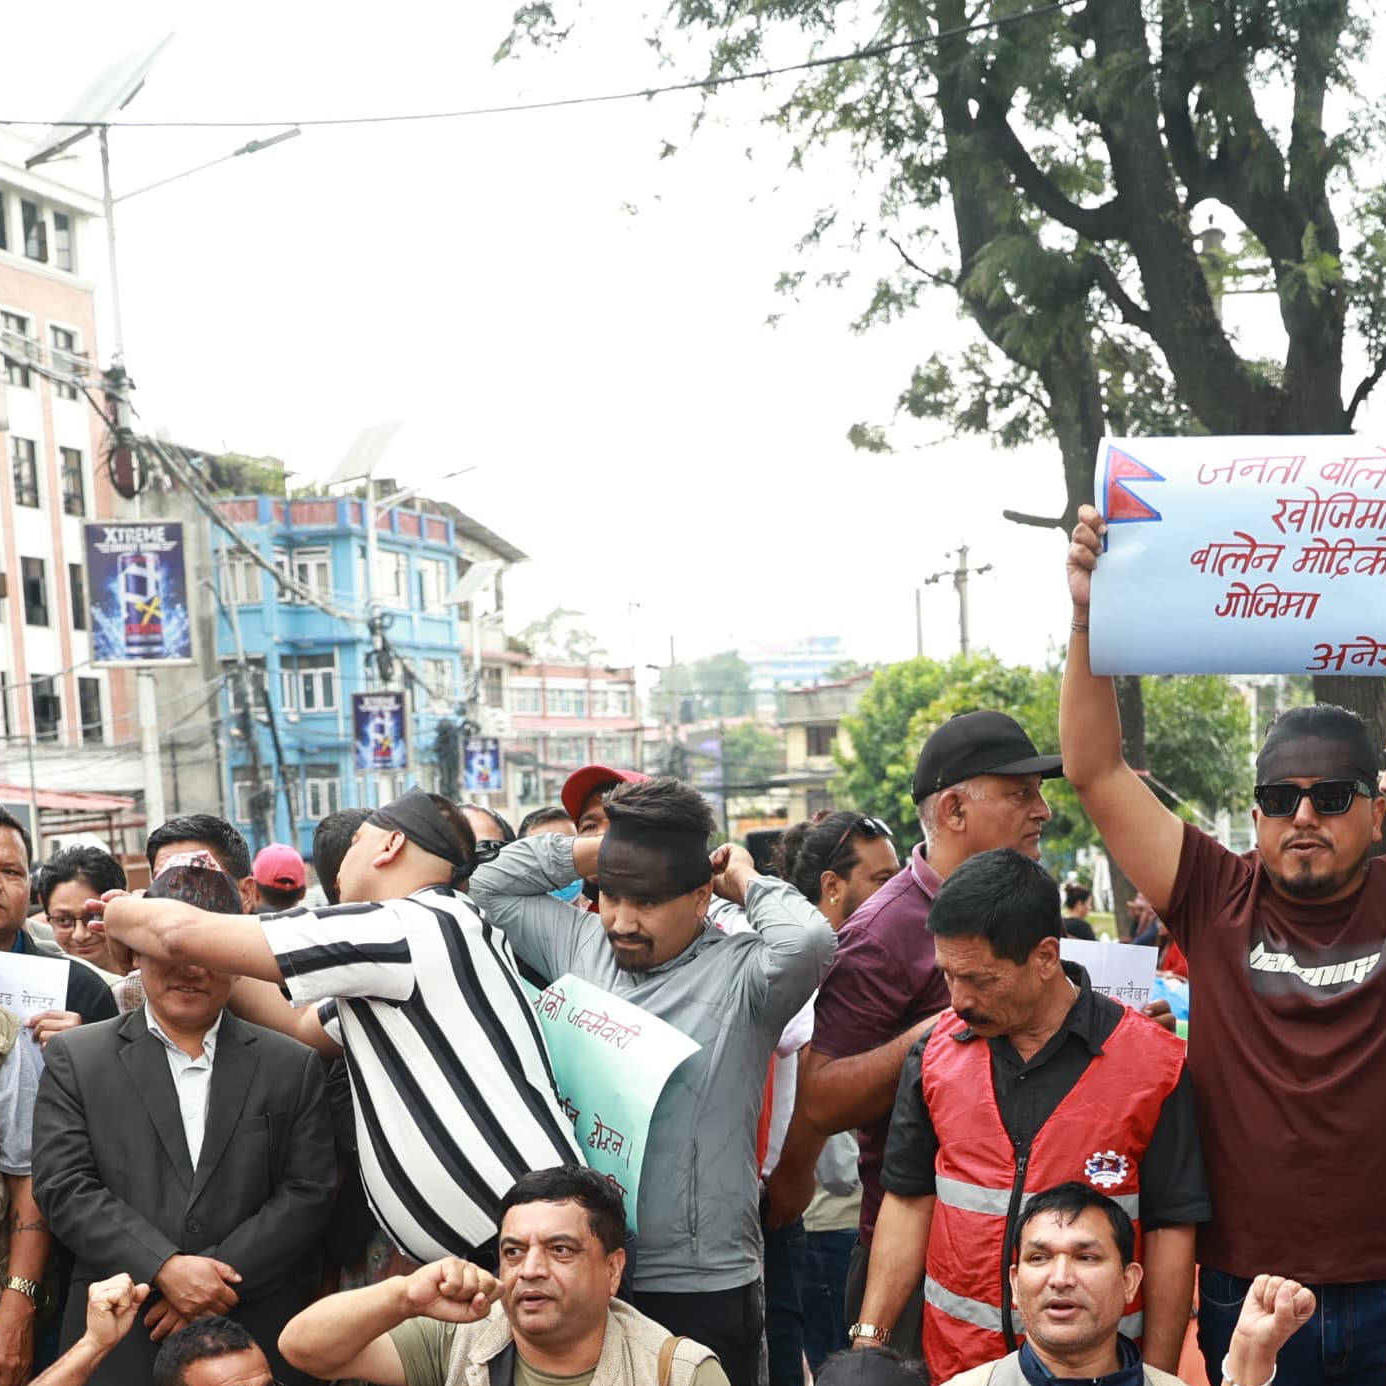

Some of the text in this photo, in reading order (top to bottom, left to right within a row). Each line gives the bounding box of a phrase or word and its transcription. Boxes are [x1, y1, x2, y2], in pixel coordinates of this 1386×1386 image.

[1196, 454, 1307, 486] जनता
[1189, 530, 1286, 578] बालेन
[1214, 581, 1321, 621] गोजिमा
